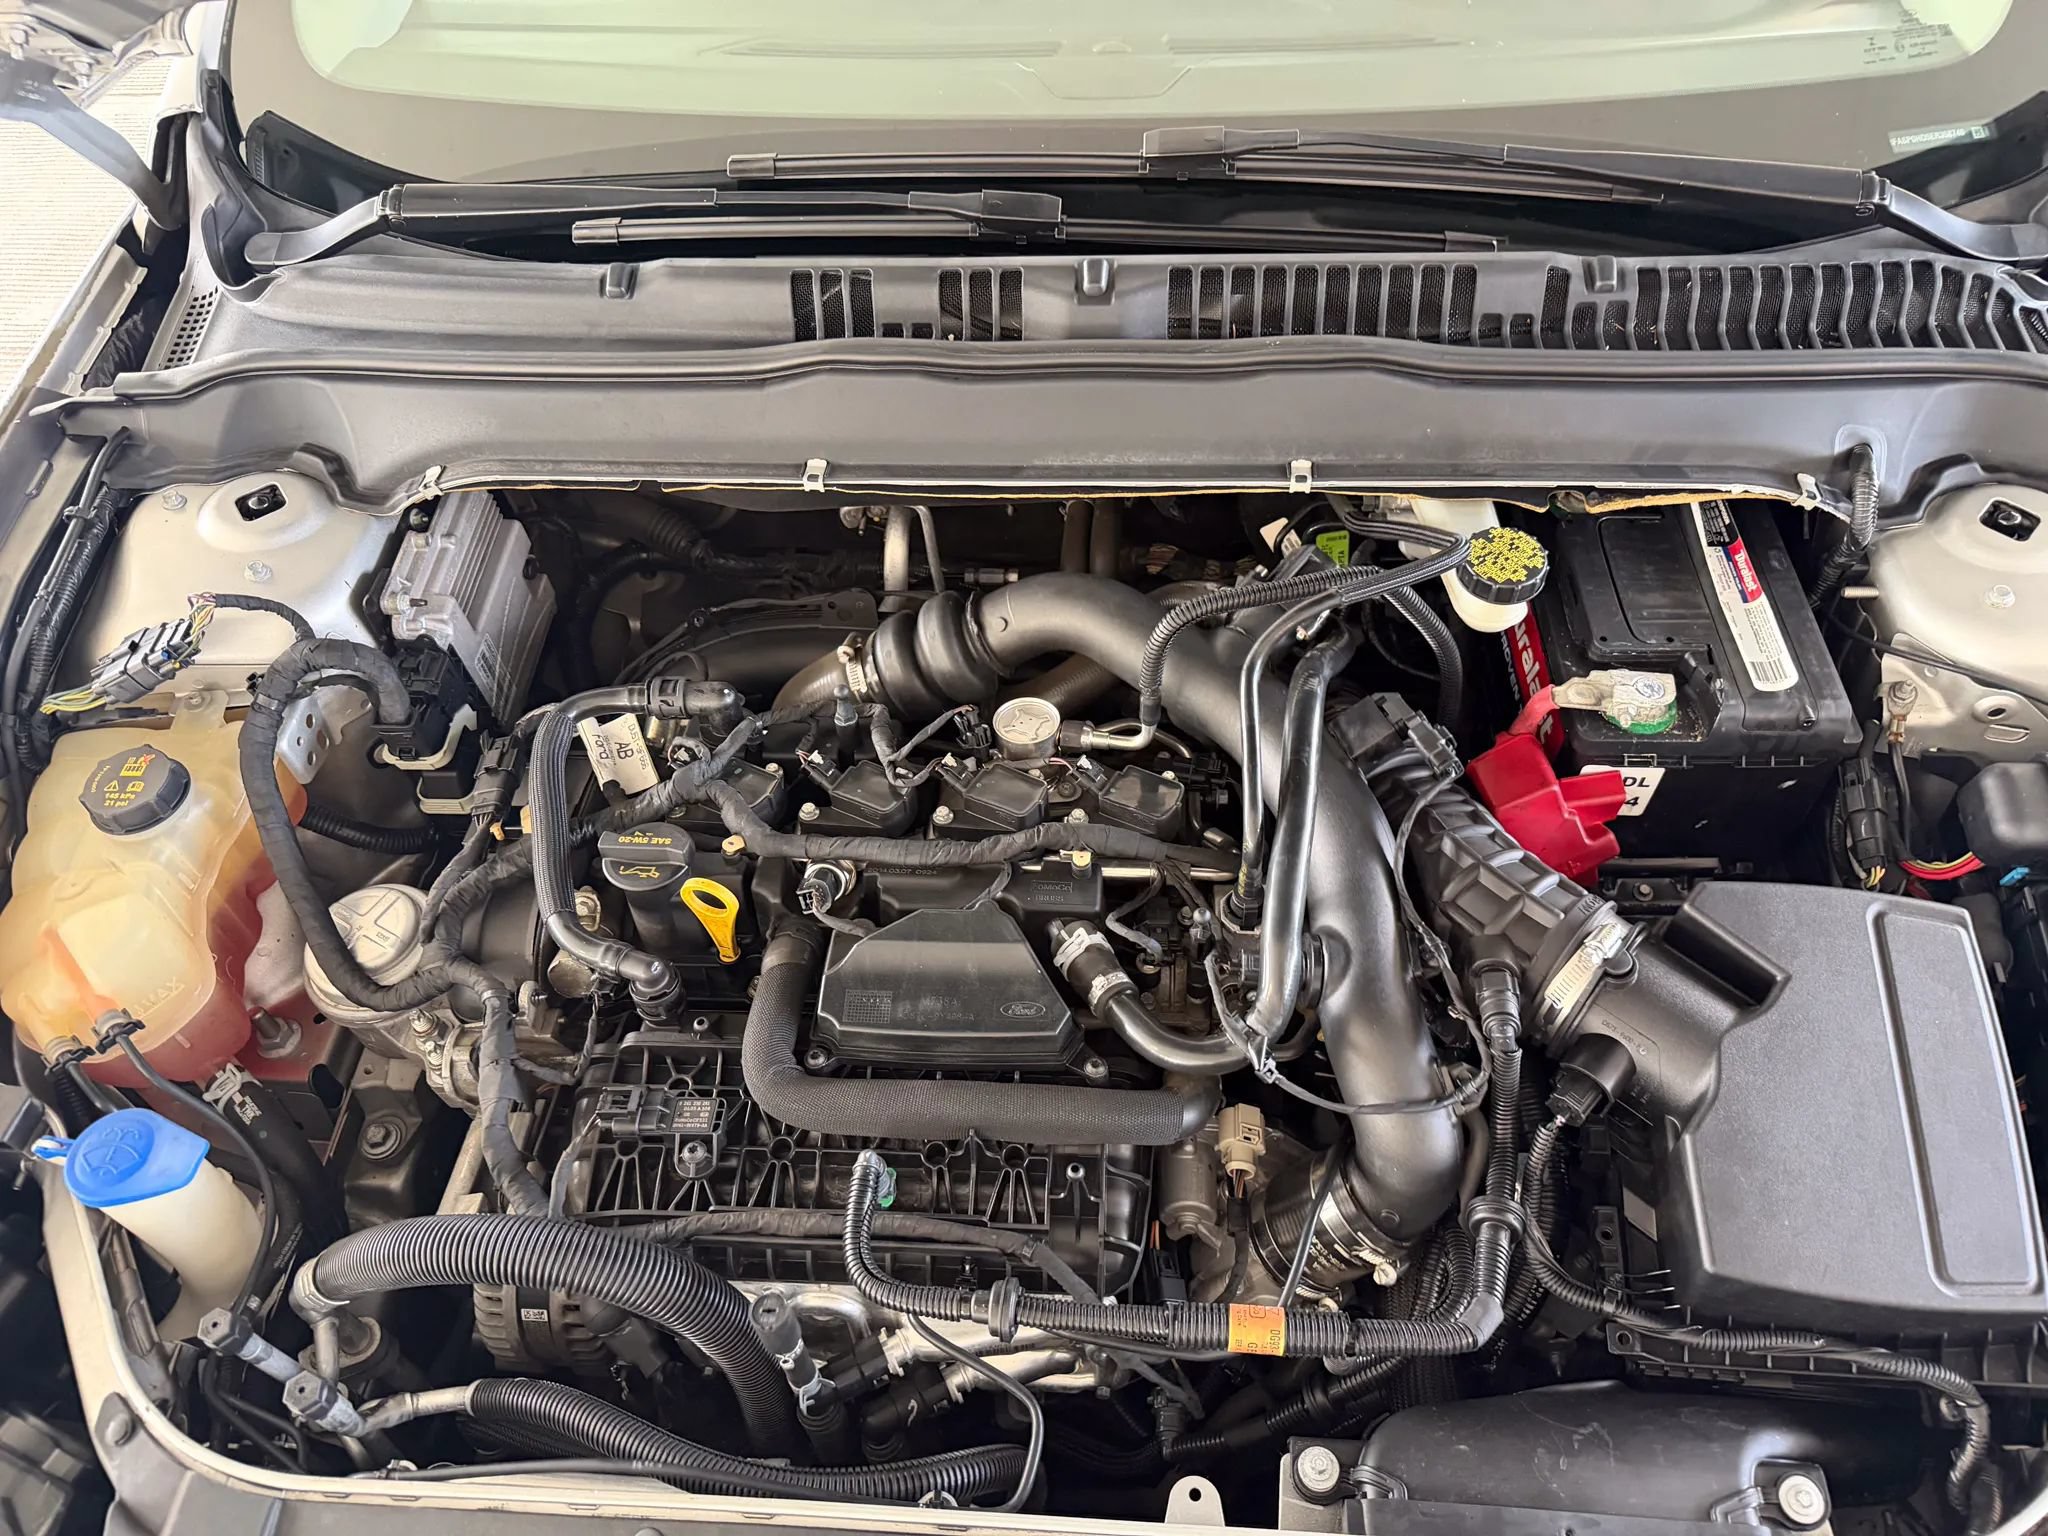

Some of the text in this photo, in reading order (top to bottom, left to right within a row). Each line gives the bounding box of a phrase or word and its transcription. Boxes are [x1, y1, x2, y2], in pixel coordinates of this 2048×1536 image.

[1734, 548, 1757, 593] Duralast
[613, 741, 635, 761] AB
[617, 835, 673, 844] SAE 5W-20
[1006, 1003, 1037, 1016] Ford
